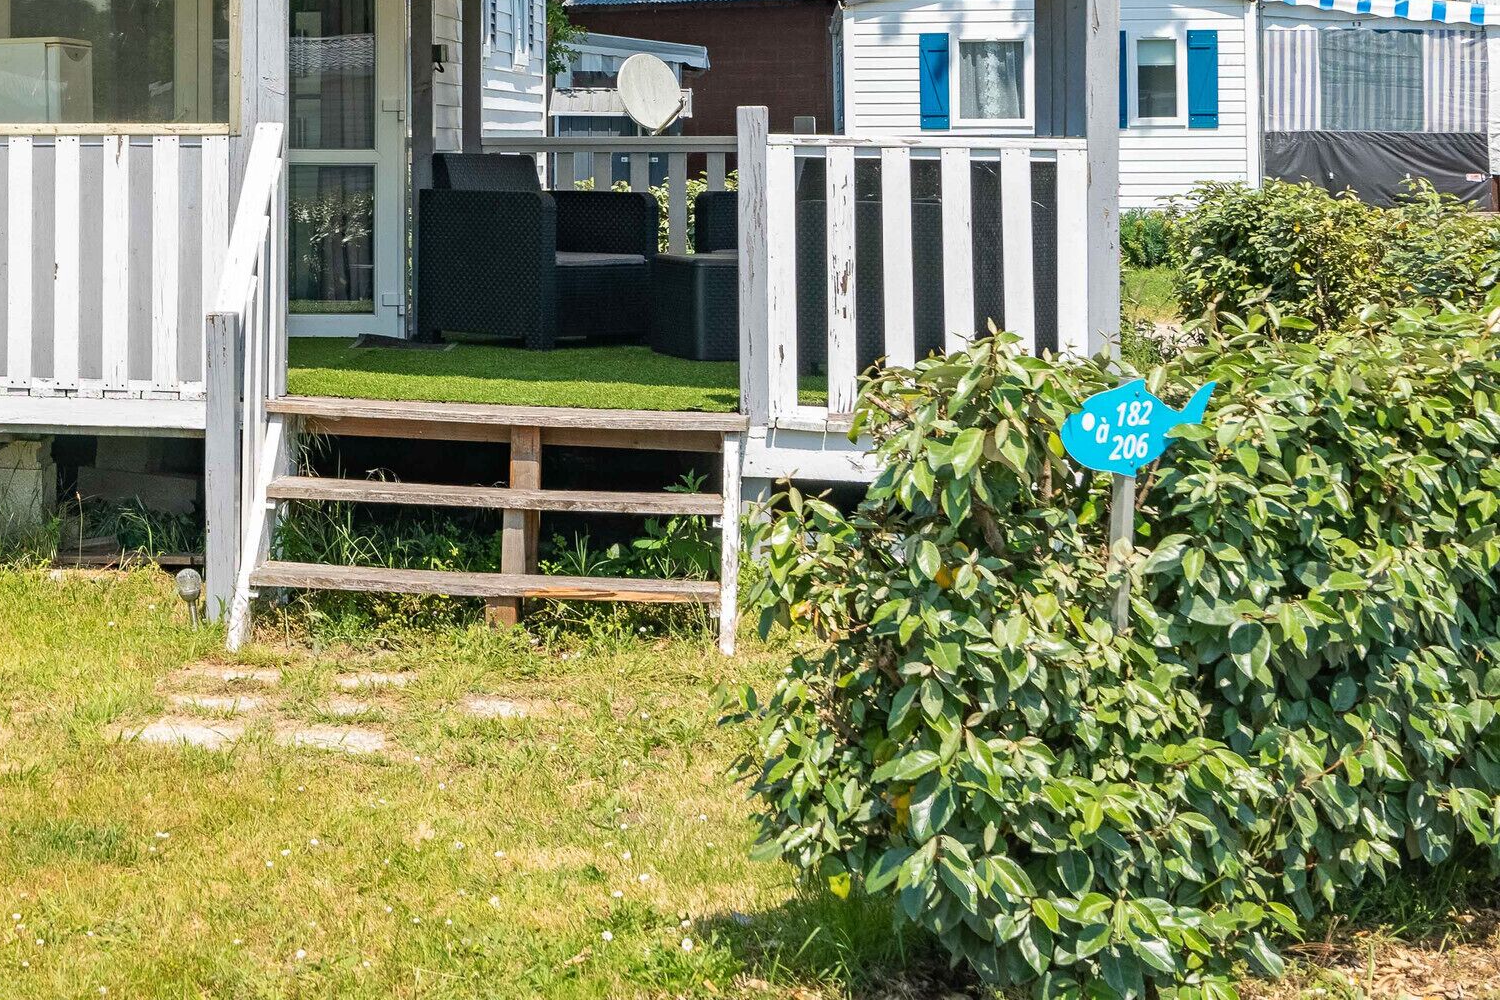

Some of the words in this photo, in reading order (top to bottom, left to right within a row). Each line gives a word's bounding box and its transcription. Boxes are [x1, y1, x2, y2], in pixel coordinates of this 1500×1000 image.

[1116, 400, 1153, 427] 182
[1095, 416, 1110, 443] à
[1108, 433, 1149, 461] 206
